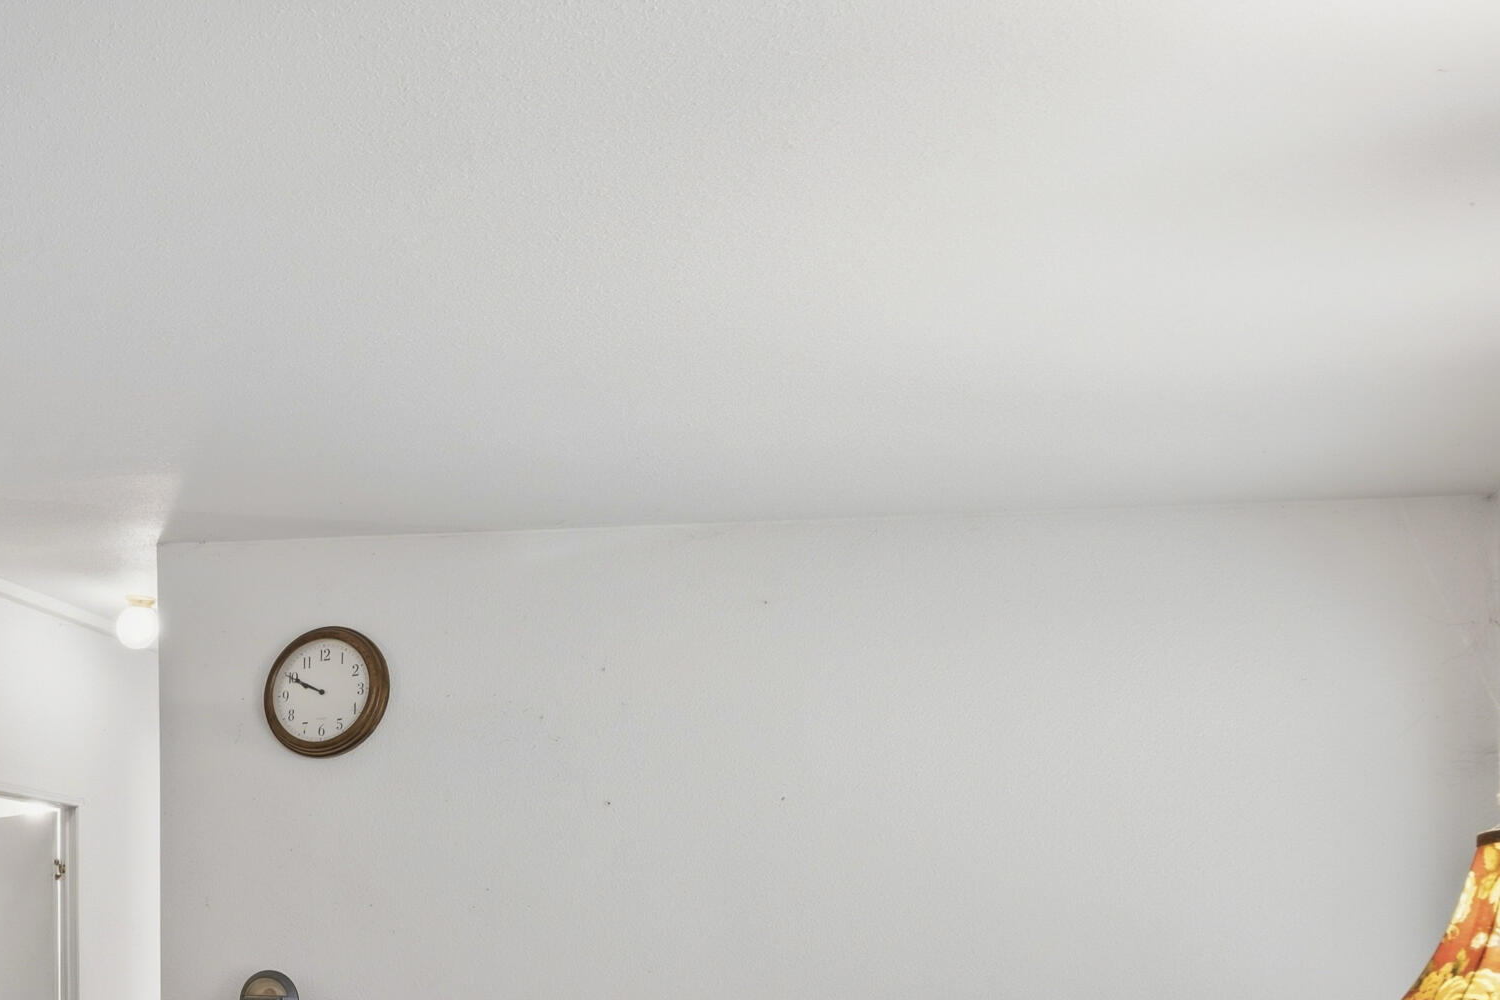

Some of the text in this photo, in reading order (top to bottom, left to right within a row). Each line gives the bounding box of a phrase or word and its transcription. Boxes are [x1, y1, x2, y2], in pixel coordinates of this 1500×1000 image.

[319, 648, 331, 662] 12
[302, 656, 312, 669] 11
[351, 663, 360, 677] 2
[357, 682, 364, 695] 3
[282, 690, 290, 702] 9
[287, 709, 295, 722] 8
[301, 721, 309, 735] 7
[317, 723, 326, 737] 6
[335, 718, 344, 730] 5
